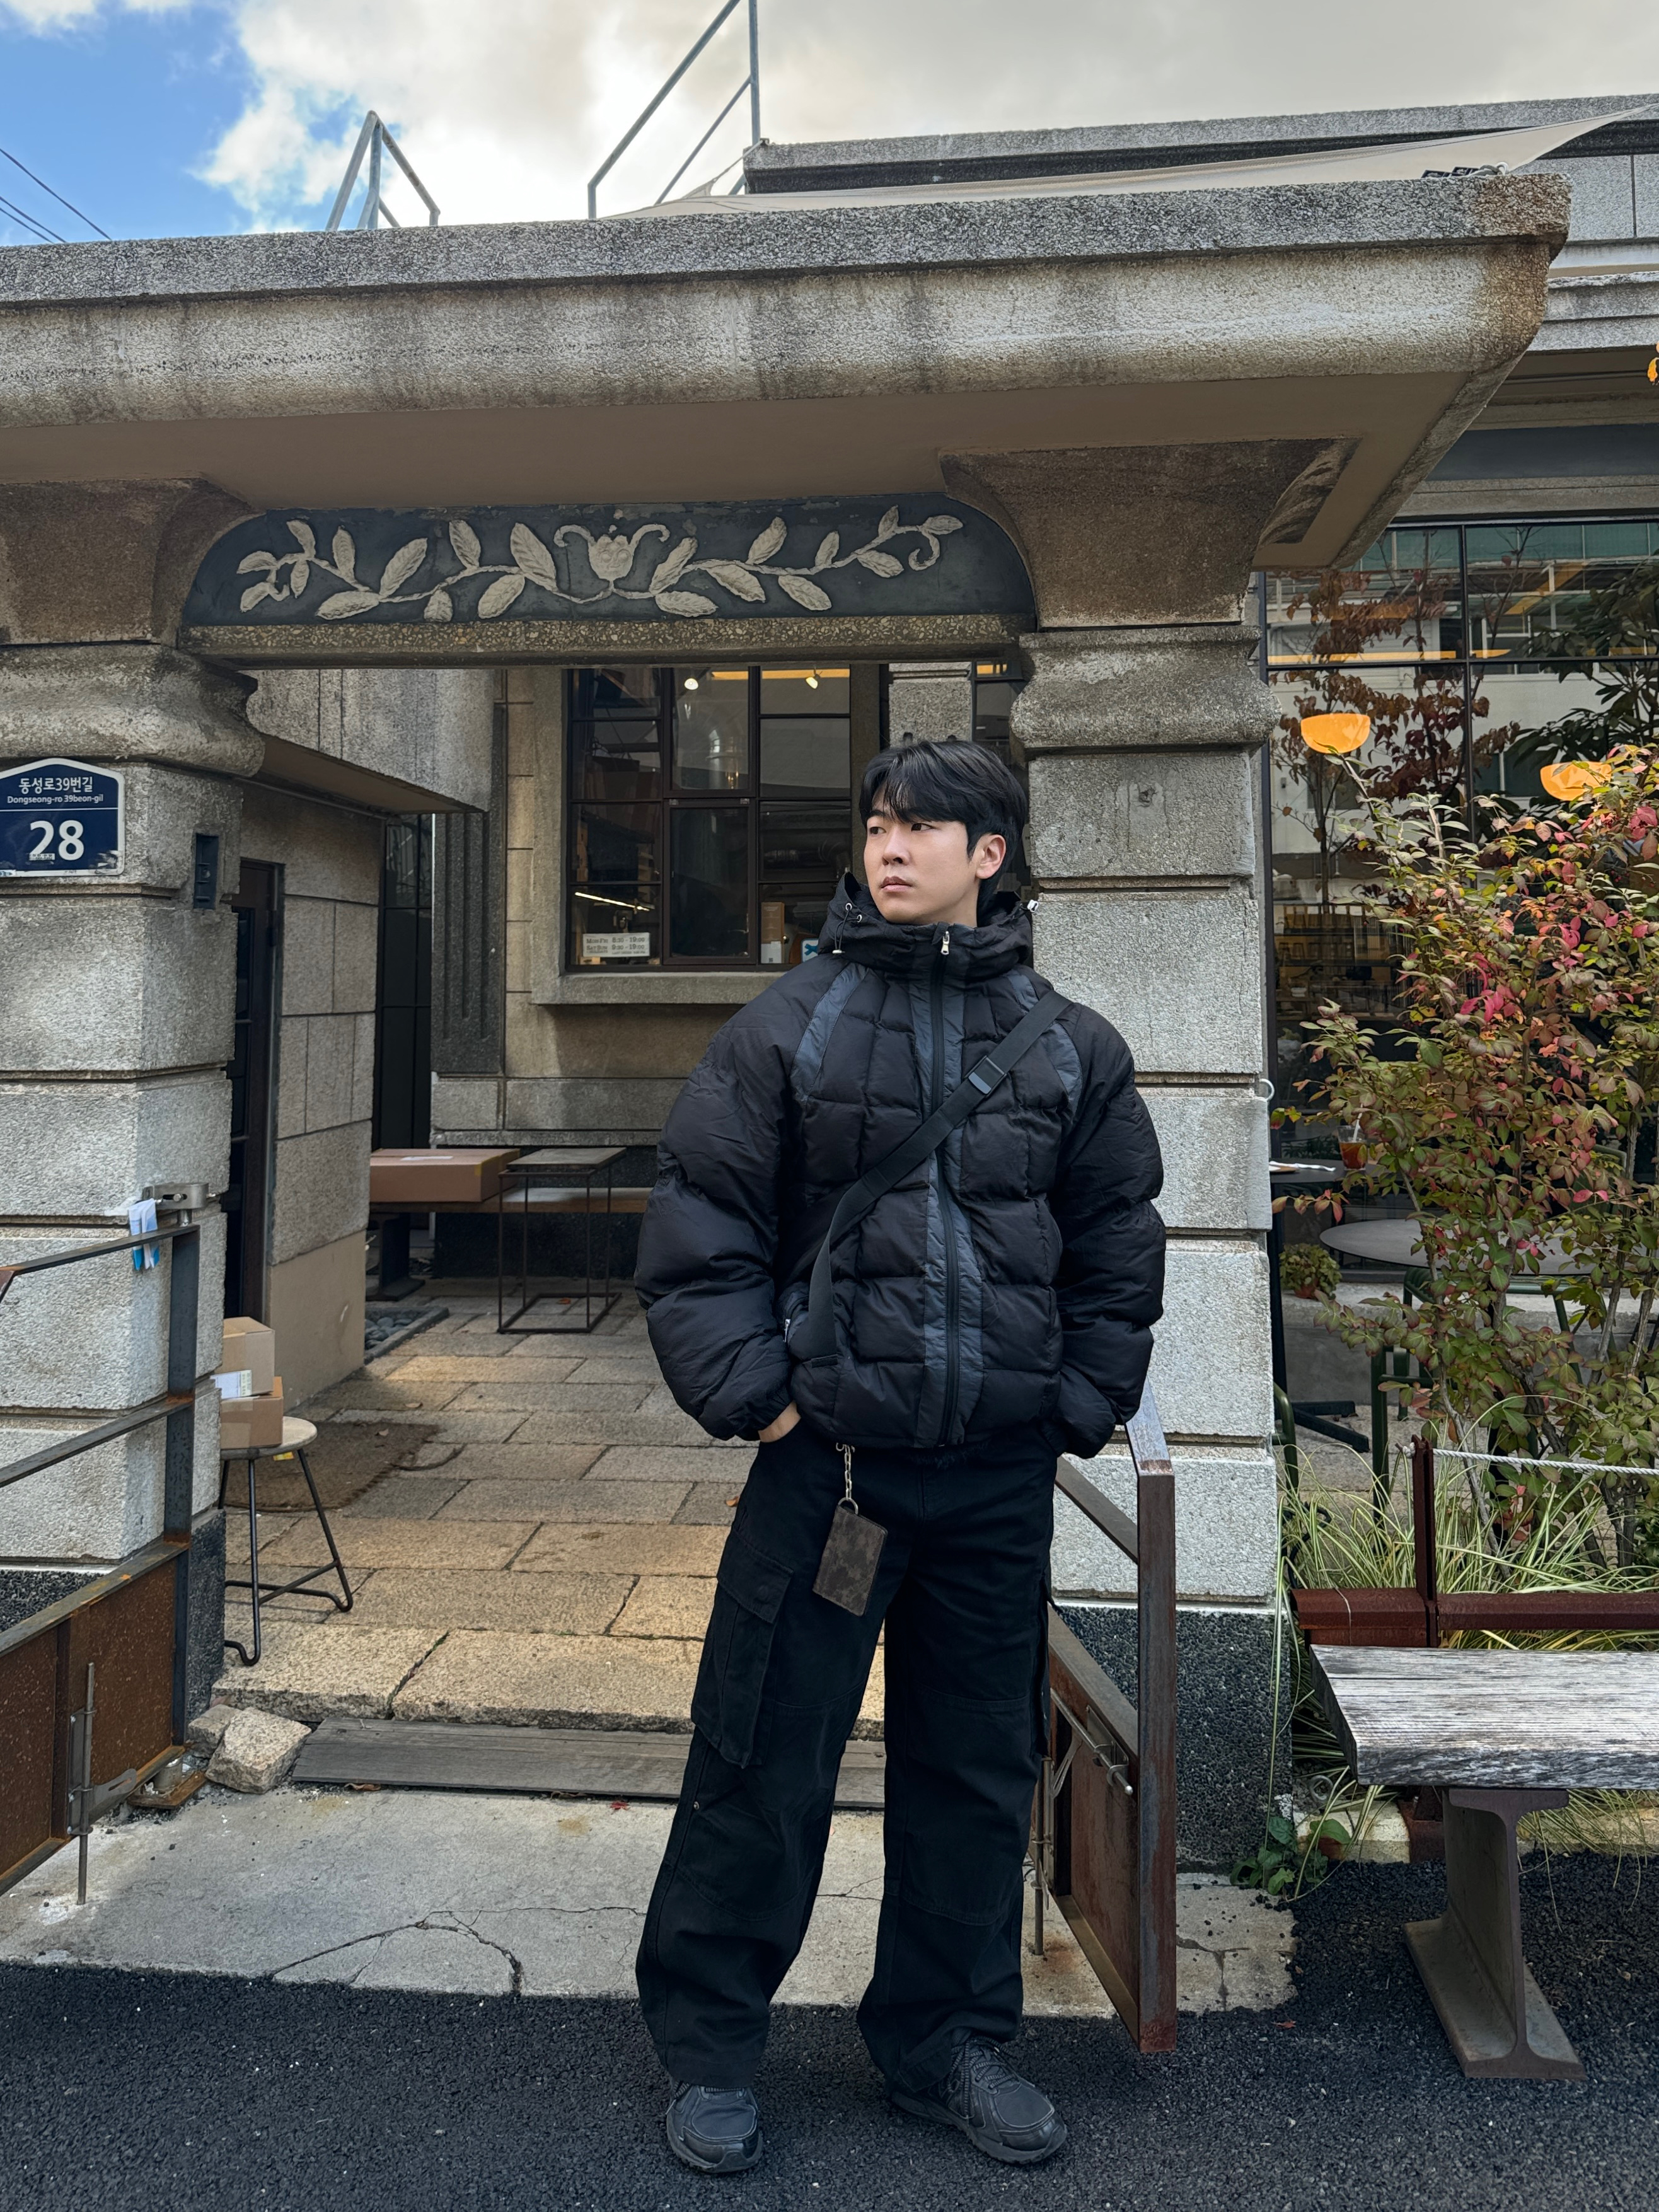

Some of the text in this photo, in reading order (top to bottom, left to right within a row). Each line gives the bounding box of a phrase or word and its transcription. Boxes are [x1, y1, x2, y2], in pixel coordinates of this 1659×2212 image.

[19, 777, 93, 794] 동성로39번길
[7, 794, 104, 805] Dongseong-ro 39beon-gil
[30, 819, 84, 861] 28
